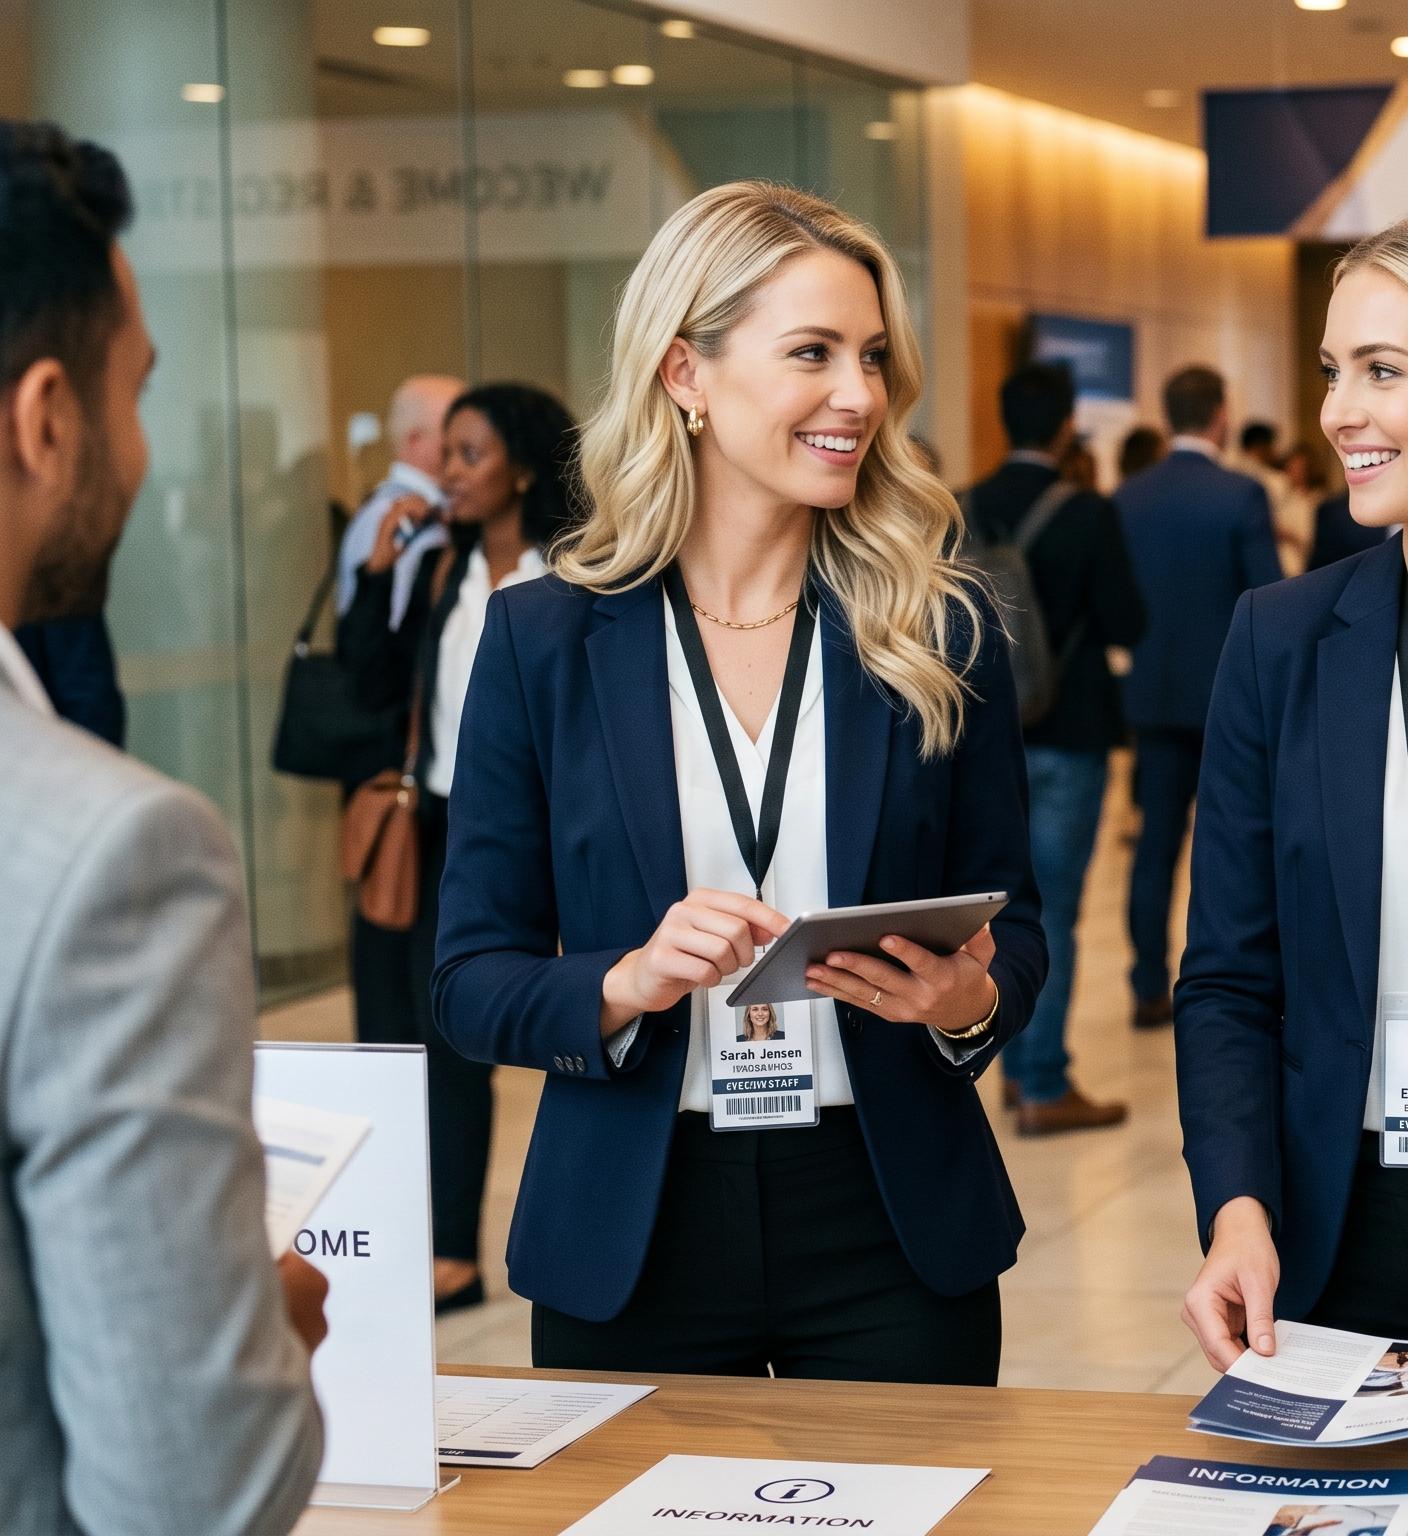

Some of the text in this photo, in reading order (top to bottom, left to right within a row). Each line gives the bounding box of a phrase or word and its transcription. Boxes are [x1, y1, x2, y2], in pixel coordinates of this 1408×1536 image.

[720, 1048, 802, 1061] Sarah Jensen
[1188, 1467, 1390, 1489] INFORMATION
